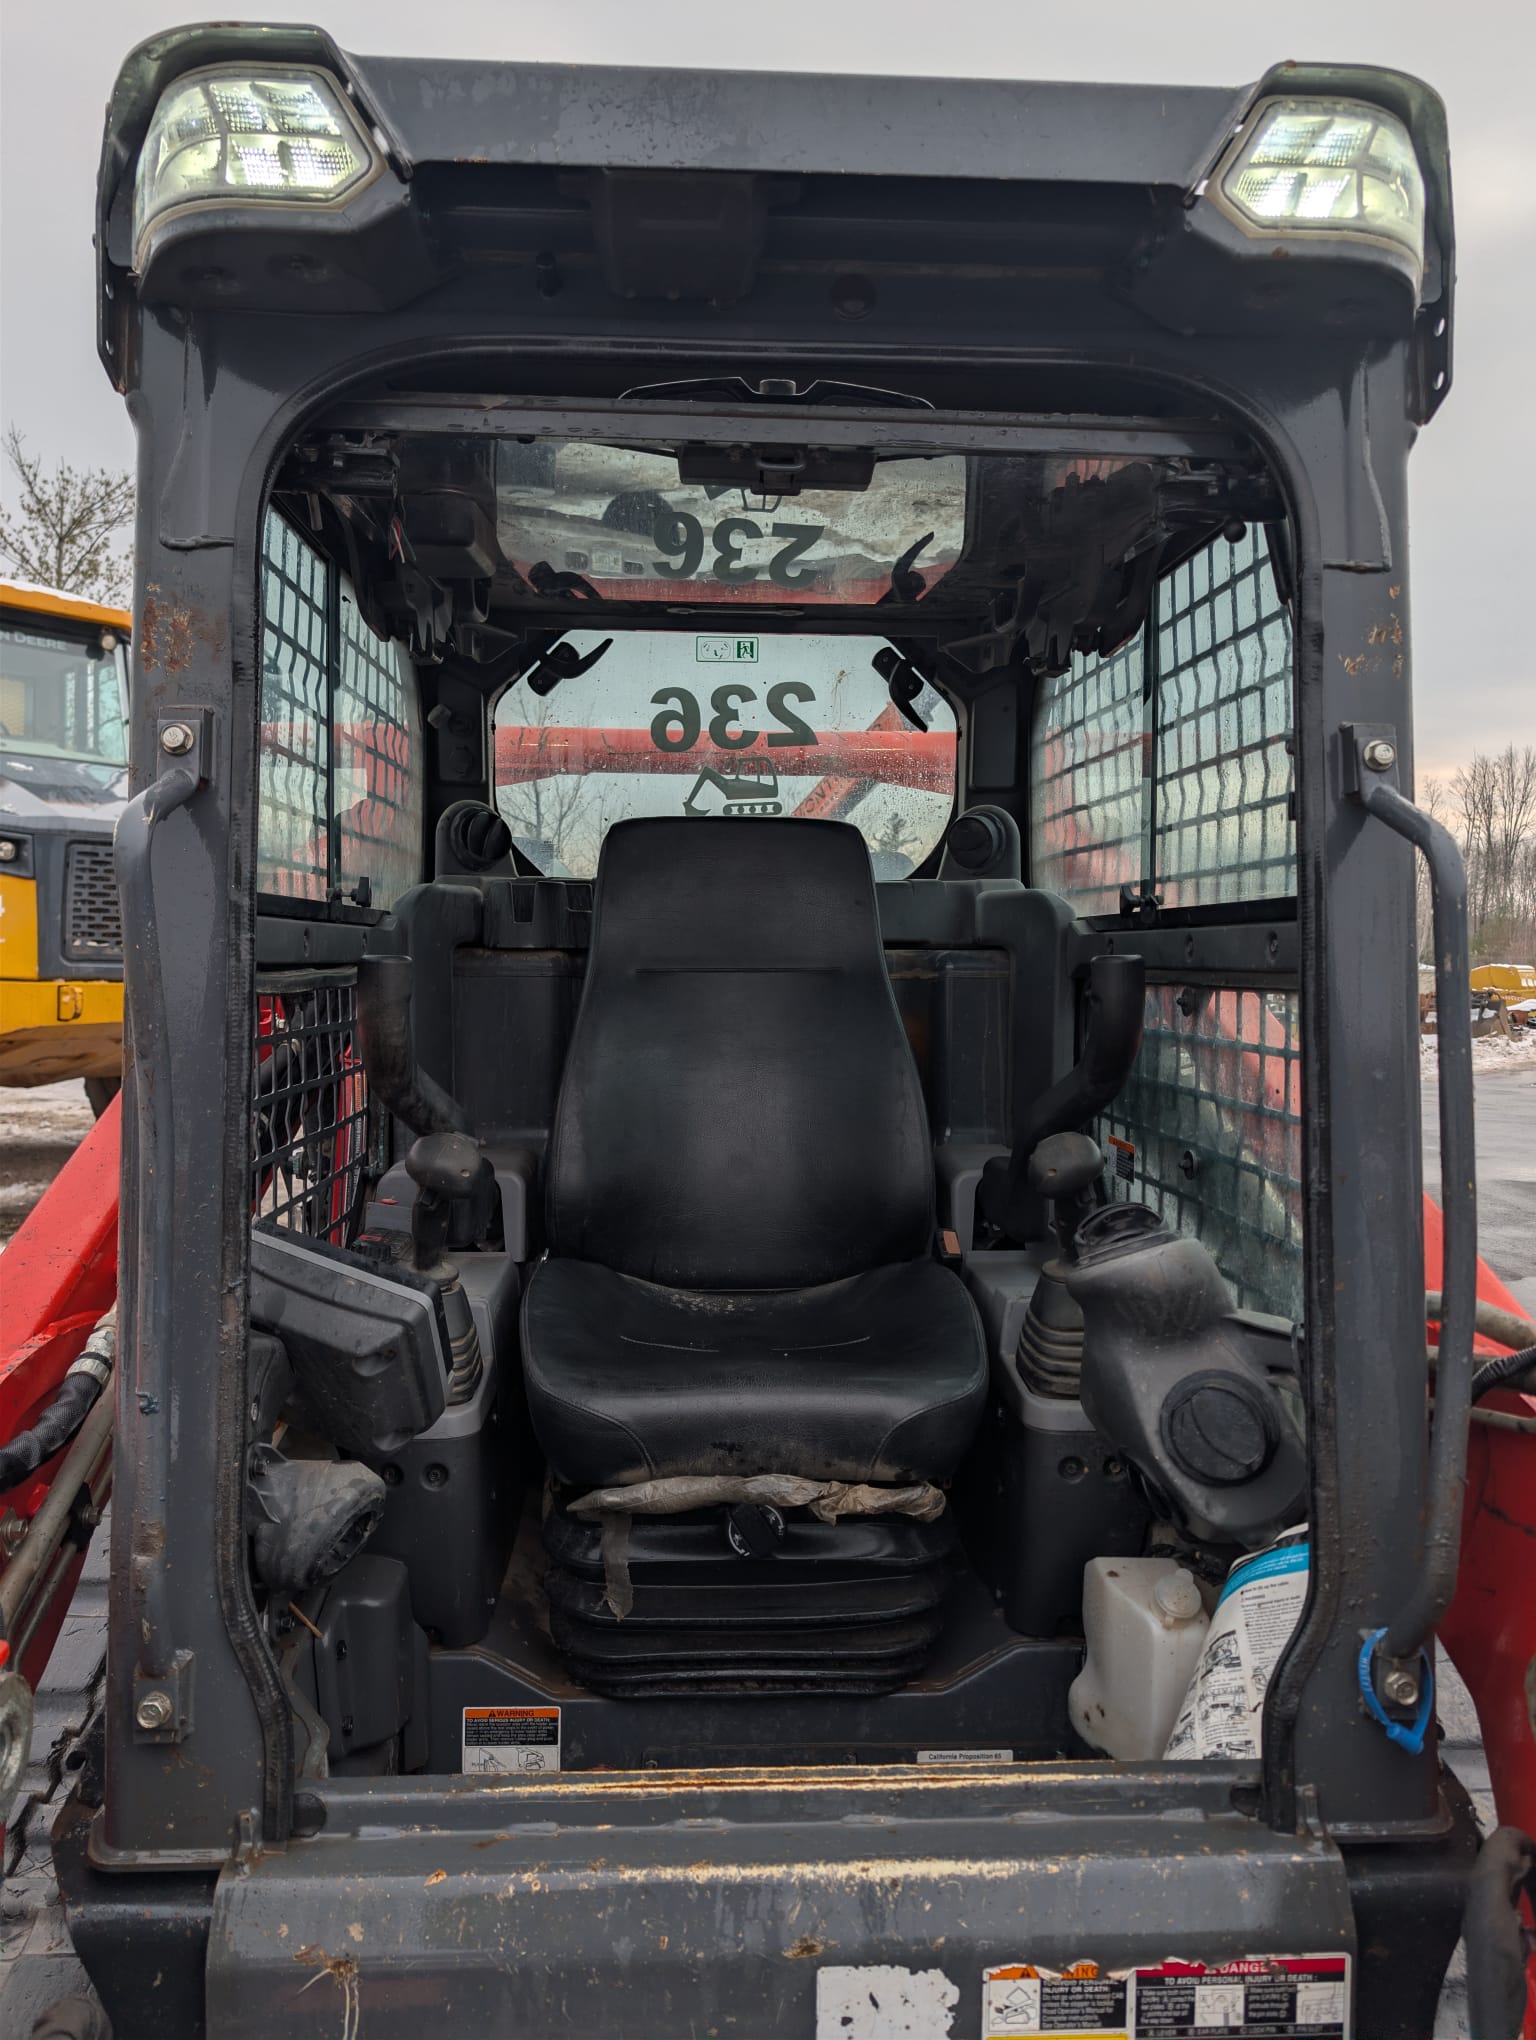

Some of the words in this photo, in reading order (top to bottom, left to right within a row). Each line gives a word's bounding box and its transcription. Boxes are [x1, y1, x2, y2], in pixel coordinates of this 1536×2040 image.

[652, 511, 824, 589] 236
[14, 631, 67, 651] DEERE
[959, 1752, 994, 1760] Proposition
[1164, 1977, 1176, 1985] TO
[1176, 1976, 1200, 1985] AVOID
[1201, 1975, 1244, 1985] PERSONAL
[1245, 1974, 1273, 1983] INJURY
